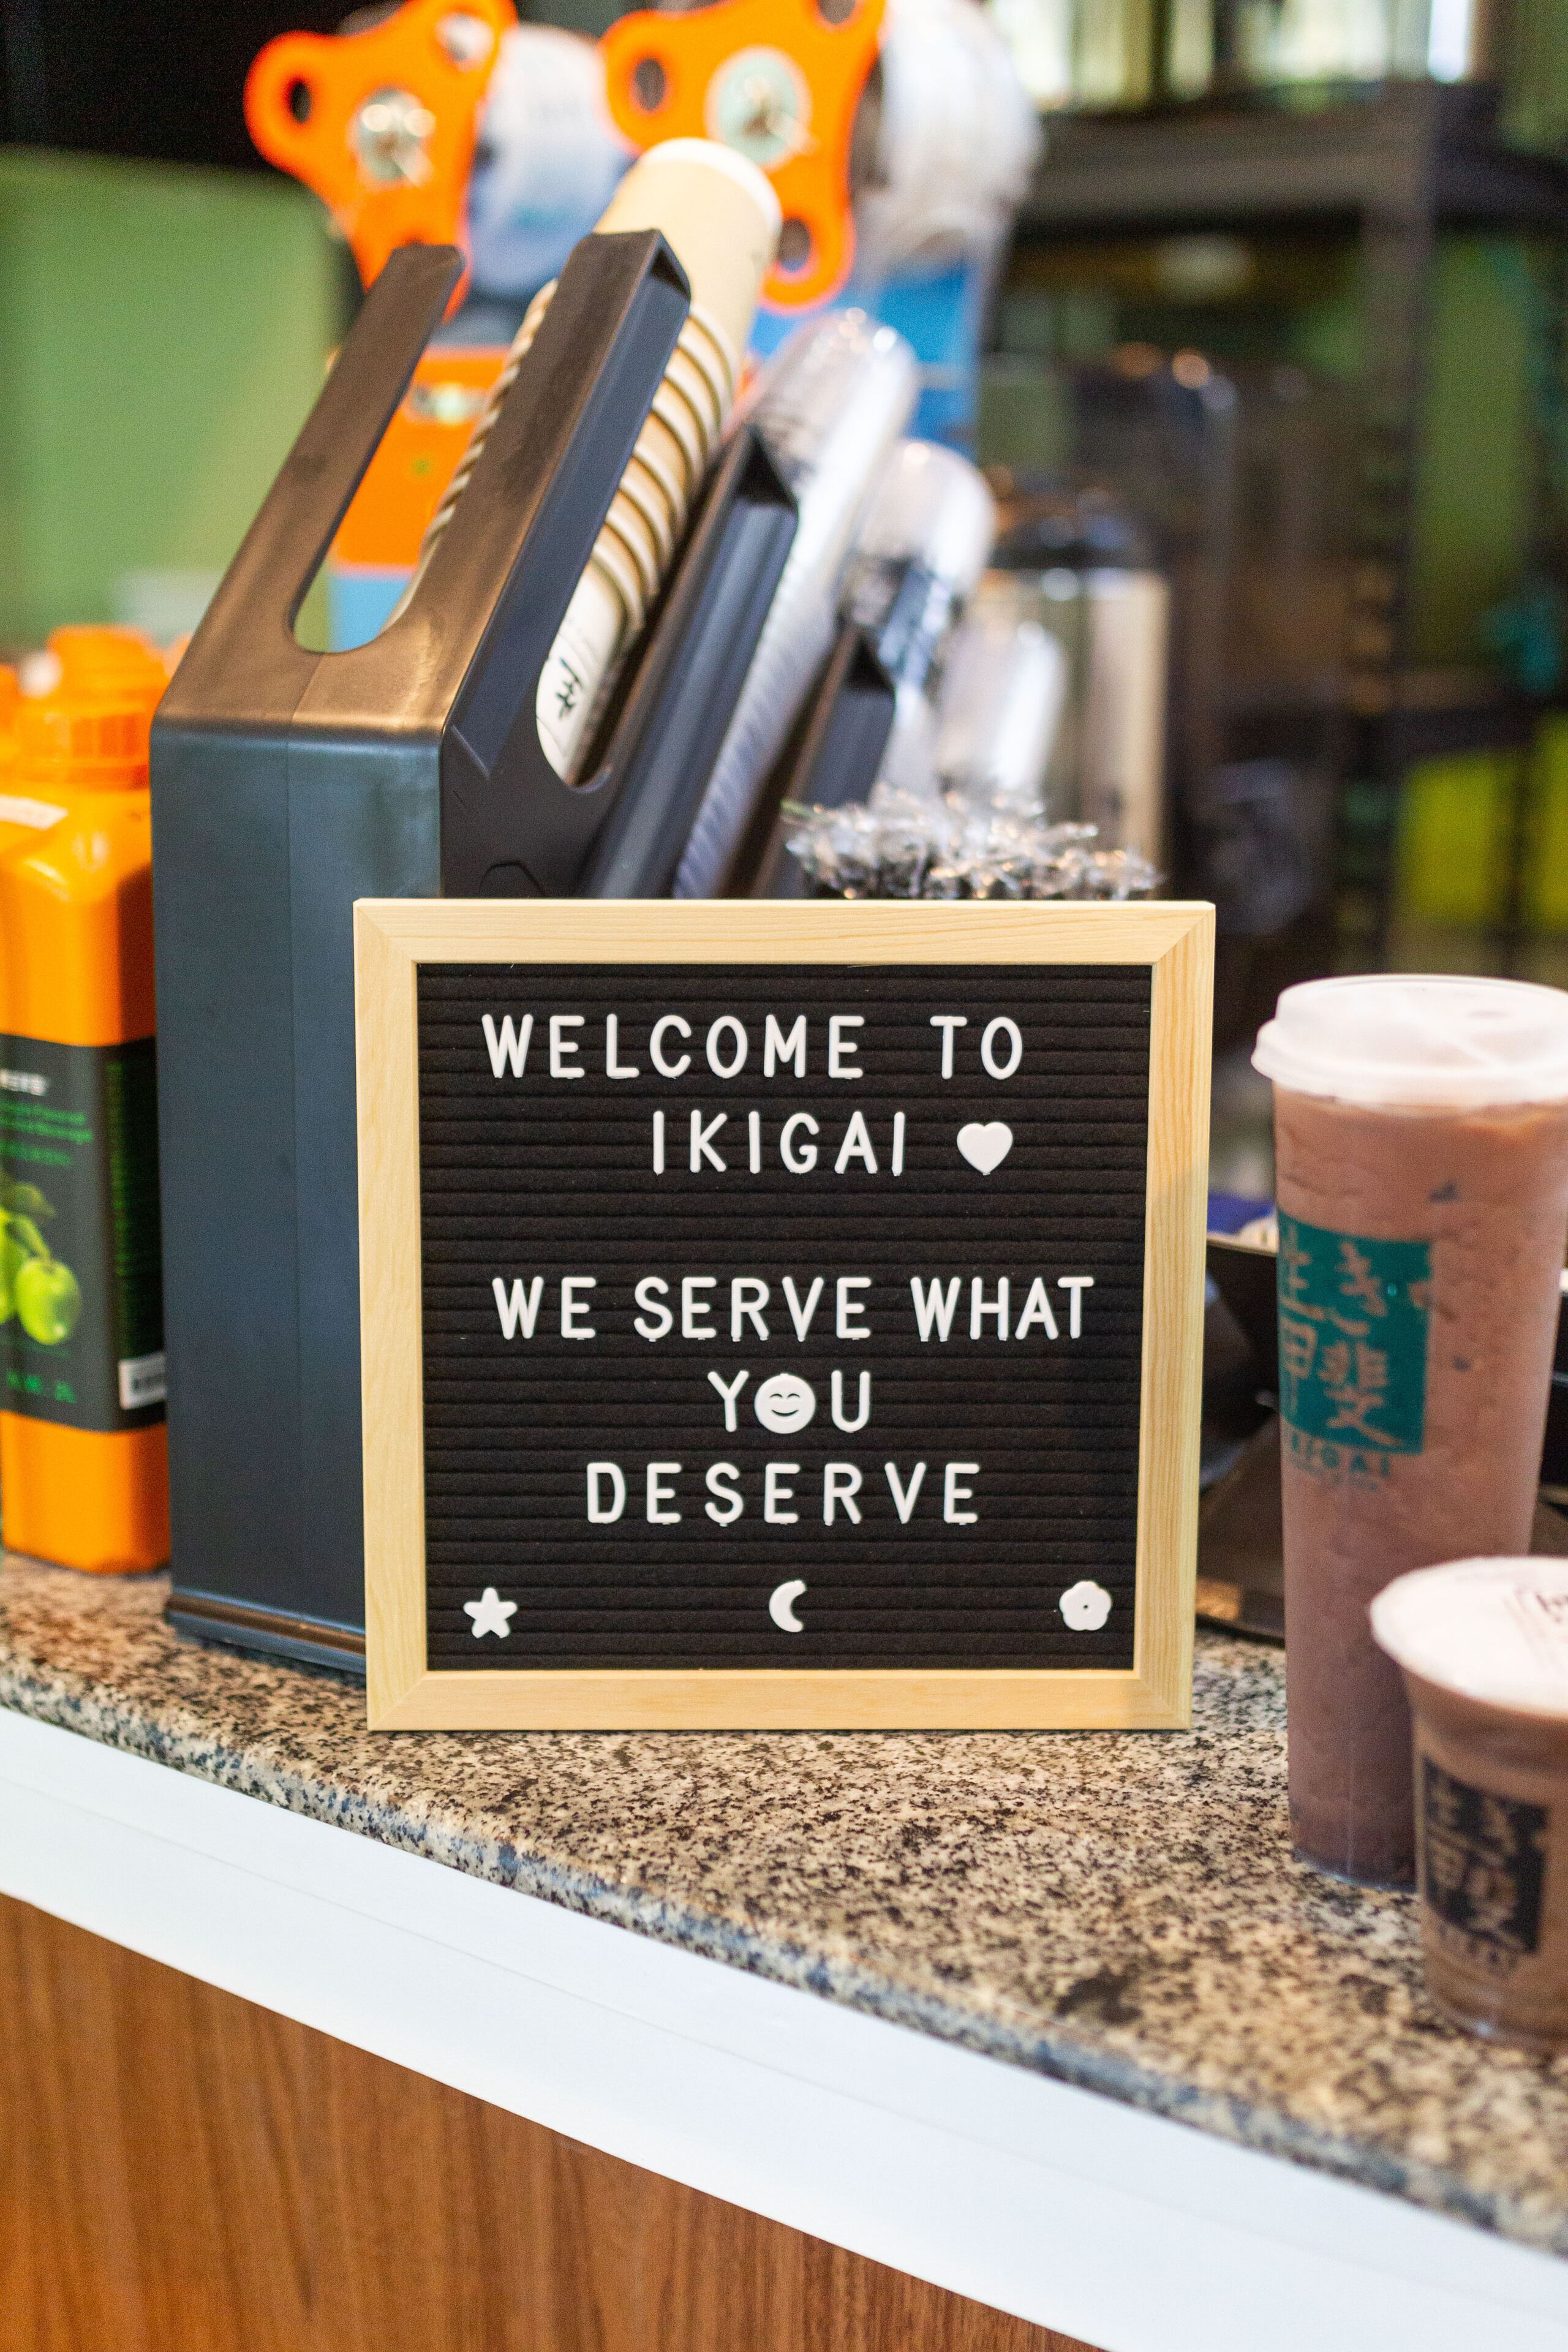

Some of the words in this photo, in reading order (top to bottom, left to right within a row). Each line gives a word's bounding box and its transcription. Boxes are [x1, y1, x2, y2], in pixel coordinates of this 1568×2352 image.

[481, 1013, 865, 1080] WELCOME
[930, 1015, 1023, 1080] TO
[653, 1110, 905, 1176] IKIGAI
[492, 1276, 597, 1340] WE
[633, 1276, 872, 1343] SERVE
[910, 1276, 1095, 1343] WHAT
[586, 1461, 980, 1526] DESERVE
